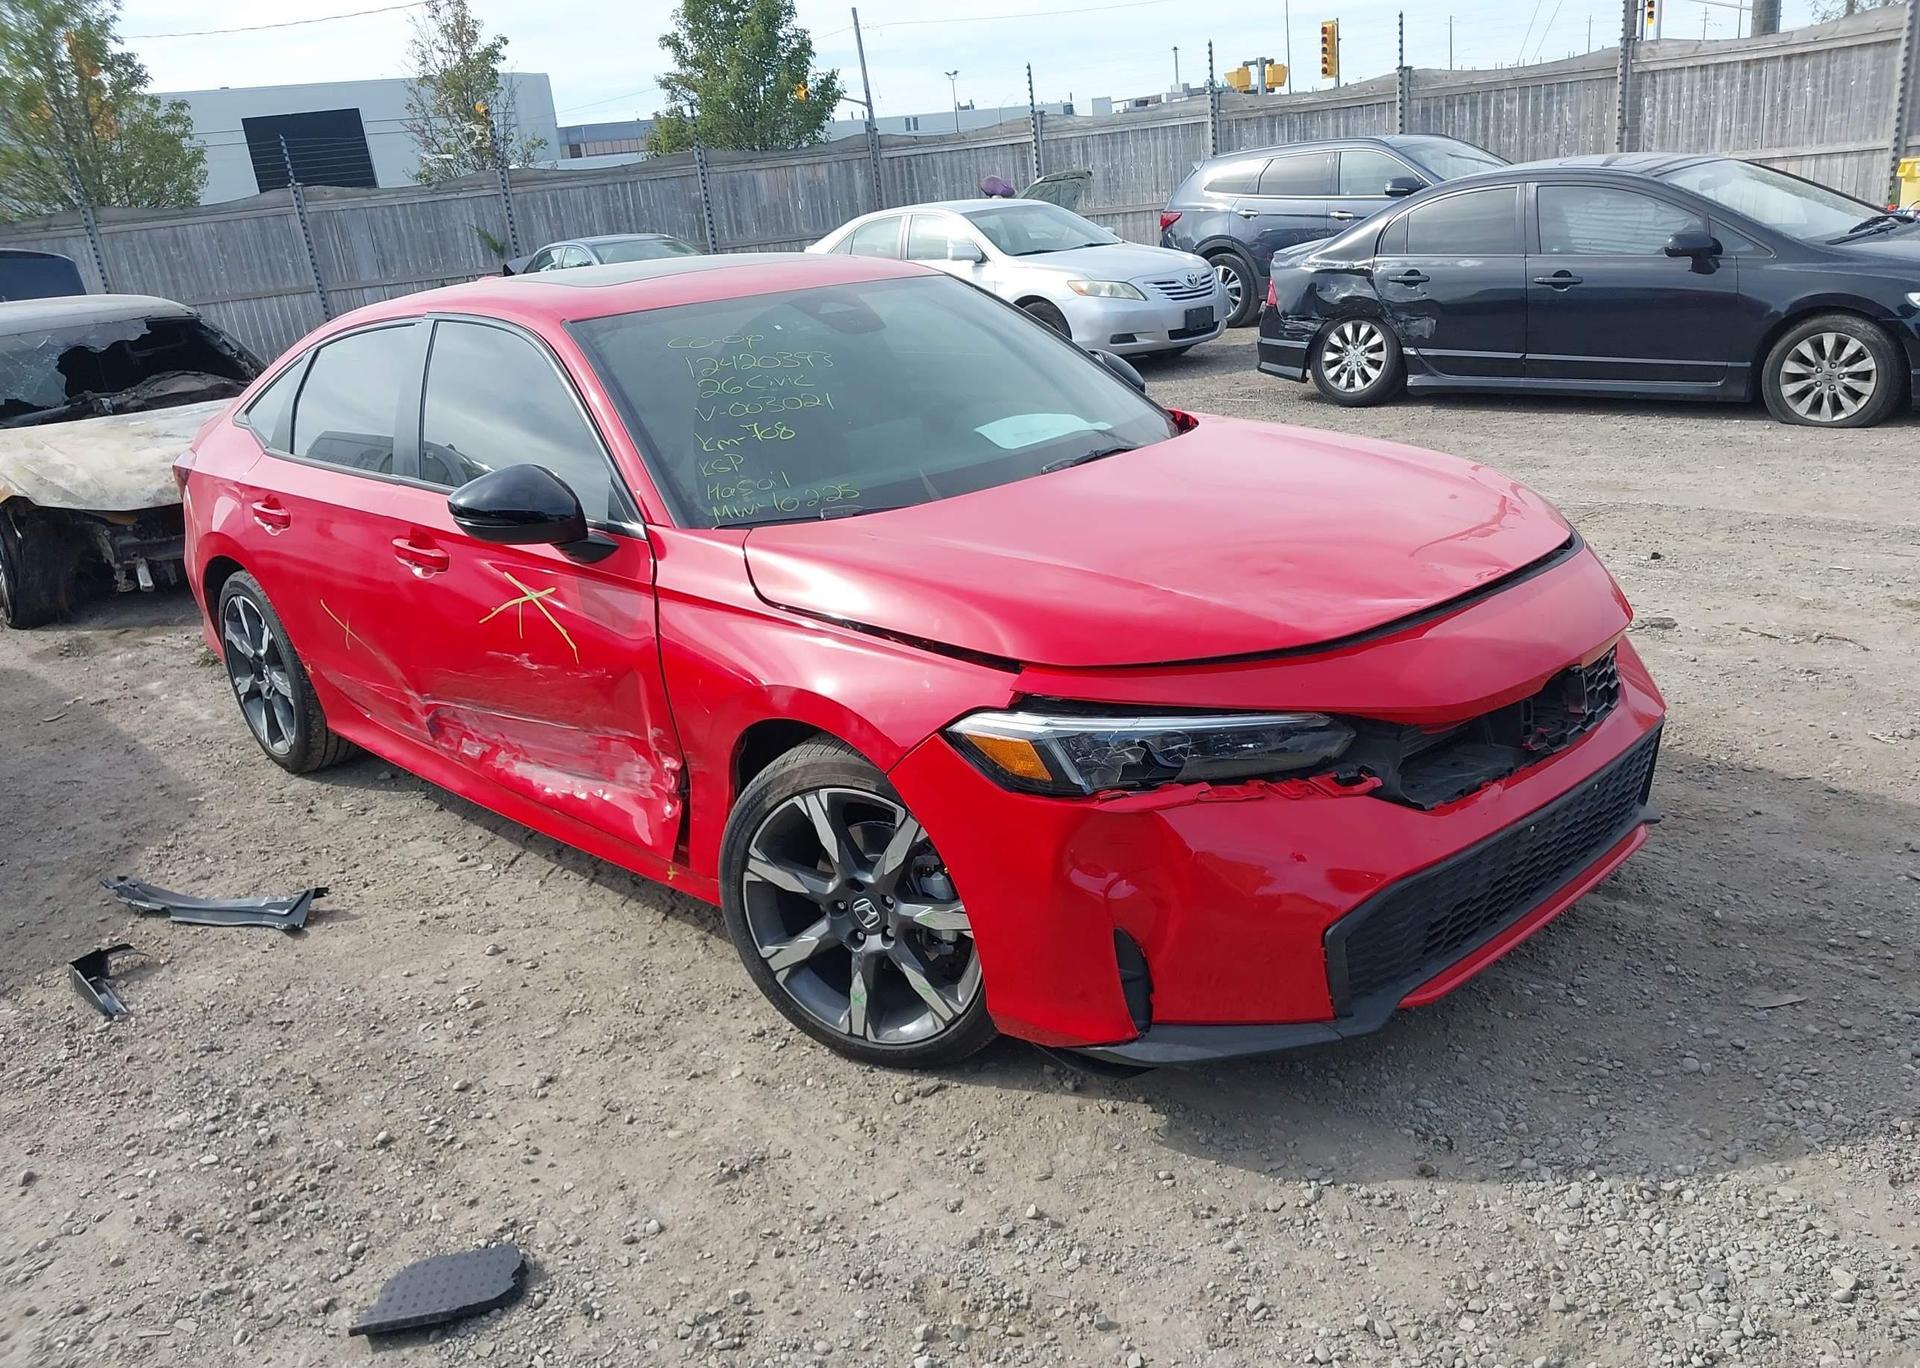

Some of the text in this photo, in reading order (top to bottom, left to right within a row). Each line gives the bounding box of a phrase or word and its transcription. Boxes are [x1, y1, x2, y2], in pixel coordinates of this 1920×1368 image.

[685, 351, 834, 378] 12420393
[697, 376, 743, 398] 26
[694, 392, 835, 422] V-003021
